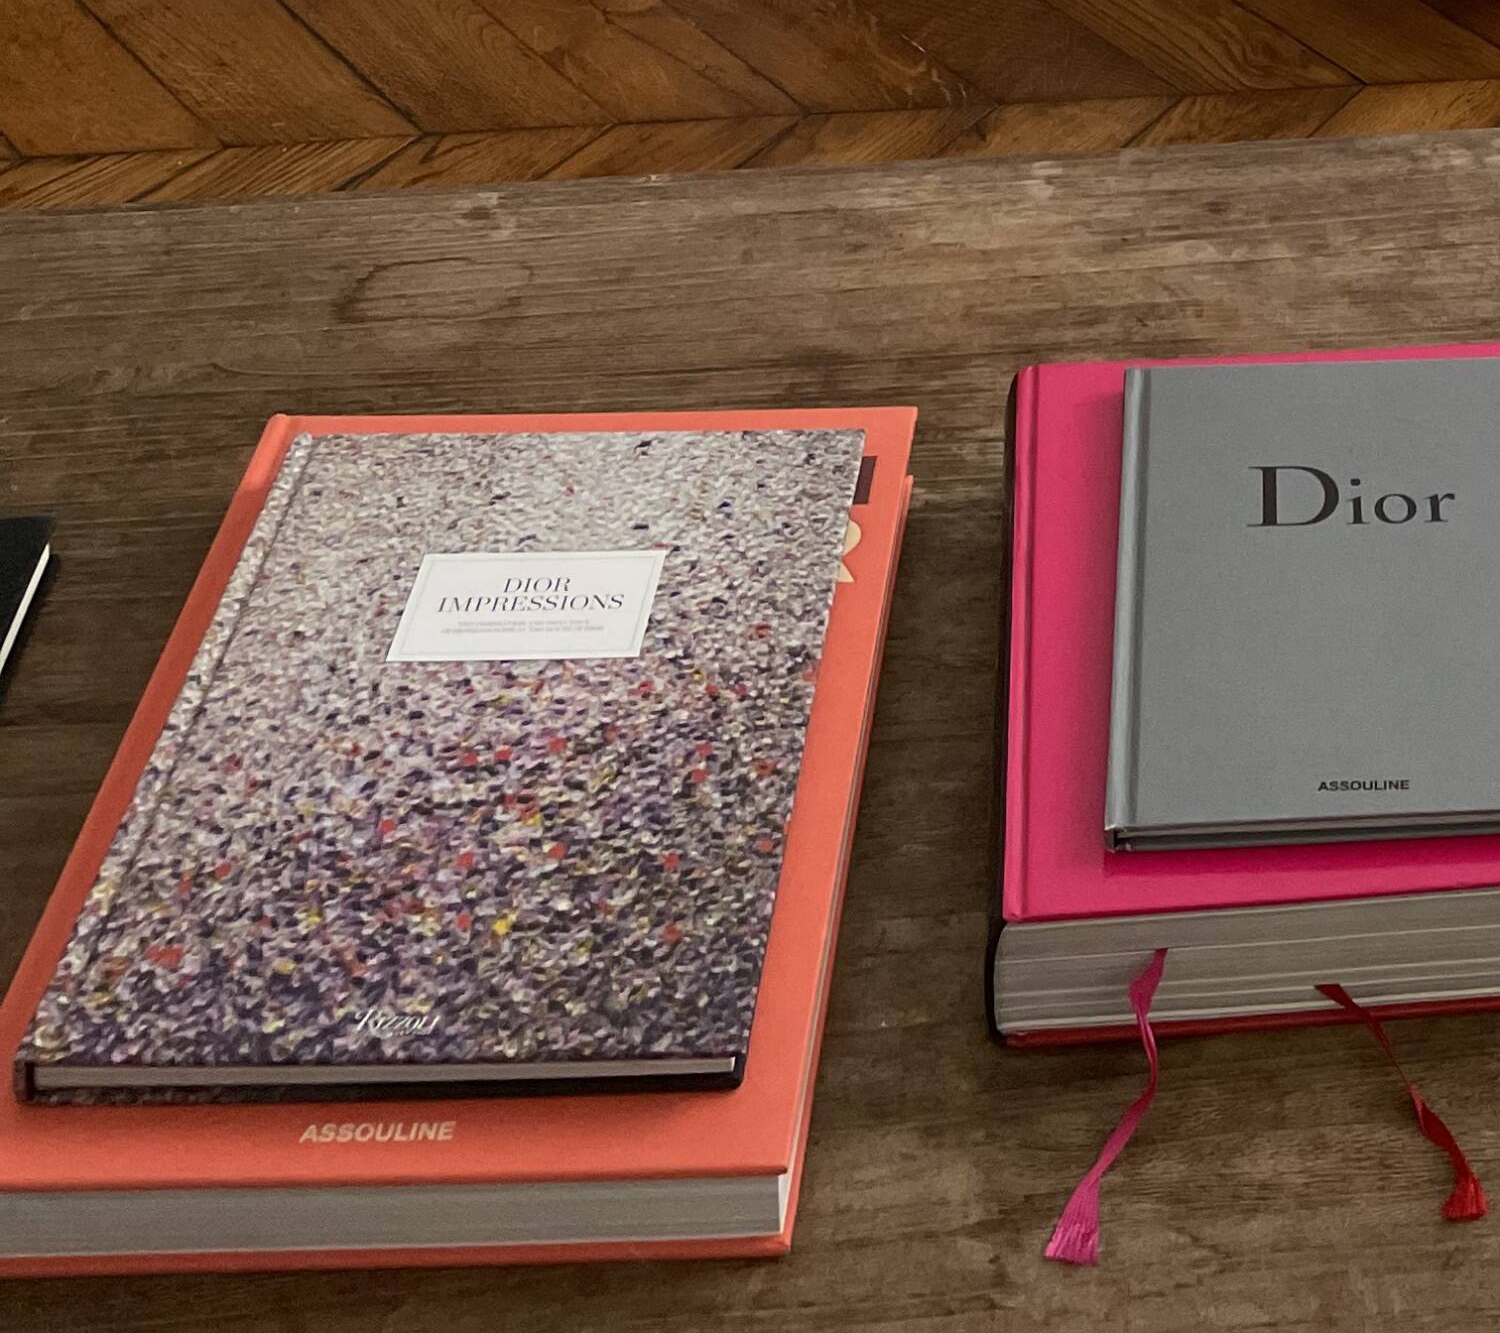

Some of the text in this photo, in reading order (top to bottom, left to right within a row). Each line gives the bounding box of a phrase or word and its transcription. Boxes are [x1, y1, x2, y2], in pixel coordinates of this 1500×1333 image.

[1246, 465, 1456, 528] Dior
[503, 577, 571, 594] DIOR
[436, 593, 625, 614] IMPRESSIONS
[1318, 779, 1410, 792] ASSOULINE
[298, 1120, 458, 1144] ASSOULINE
